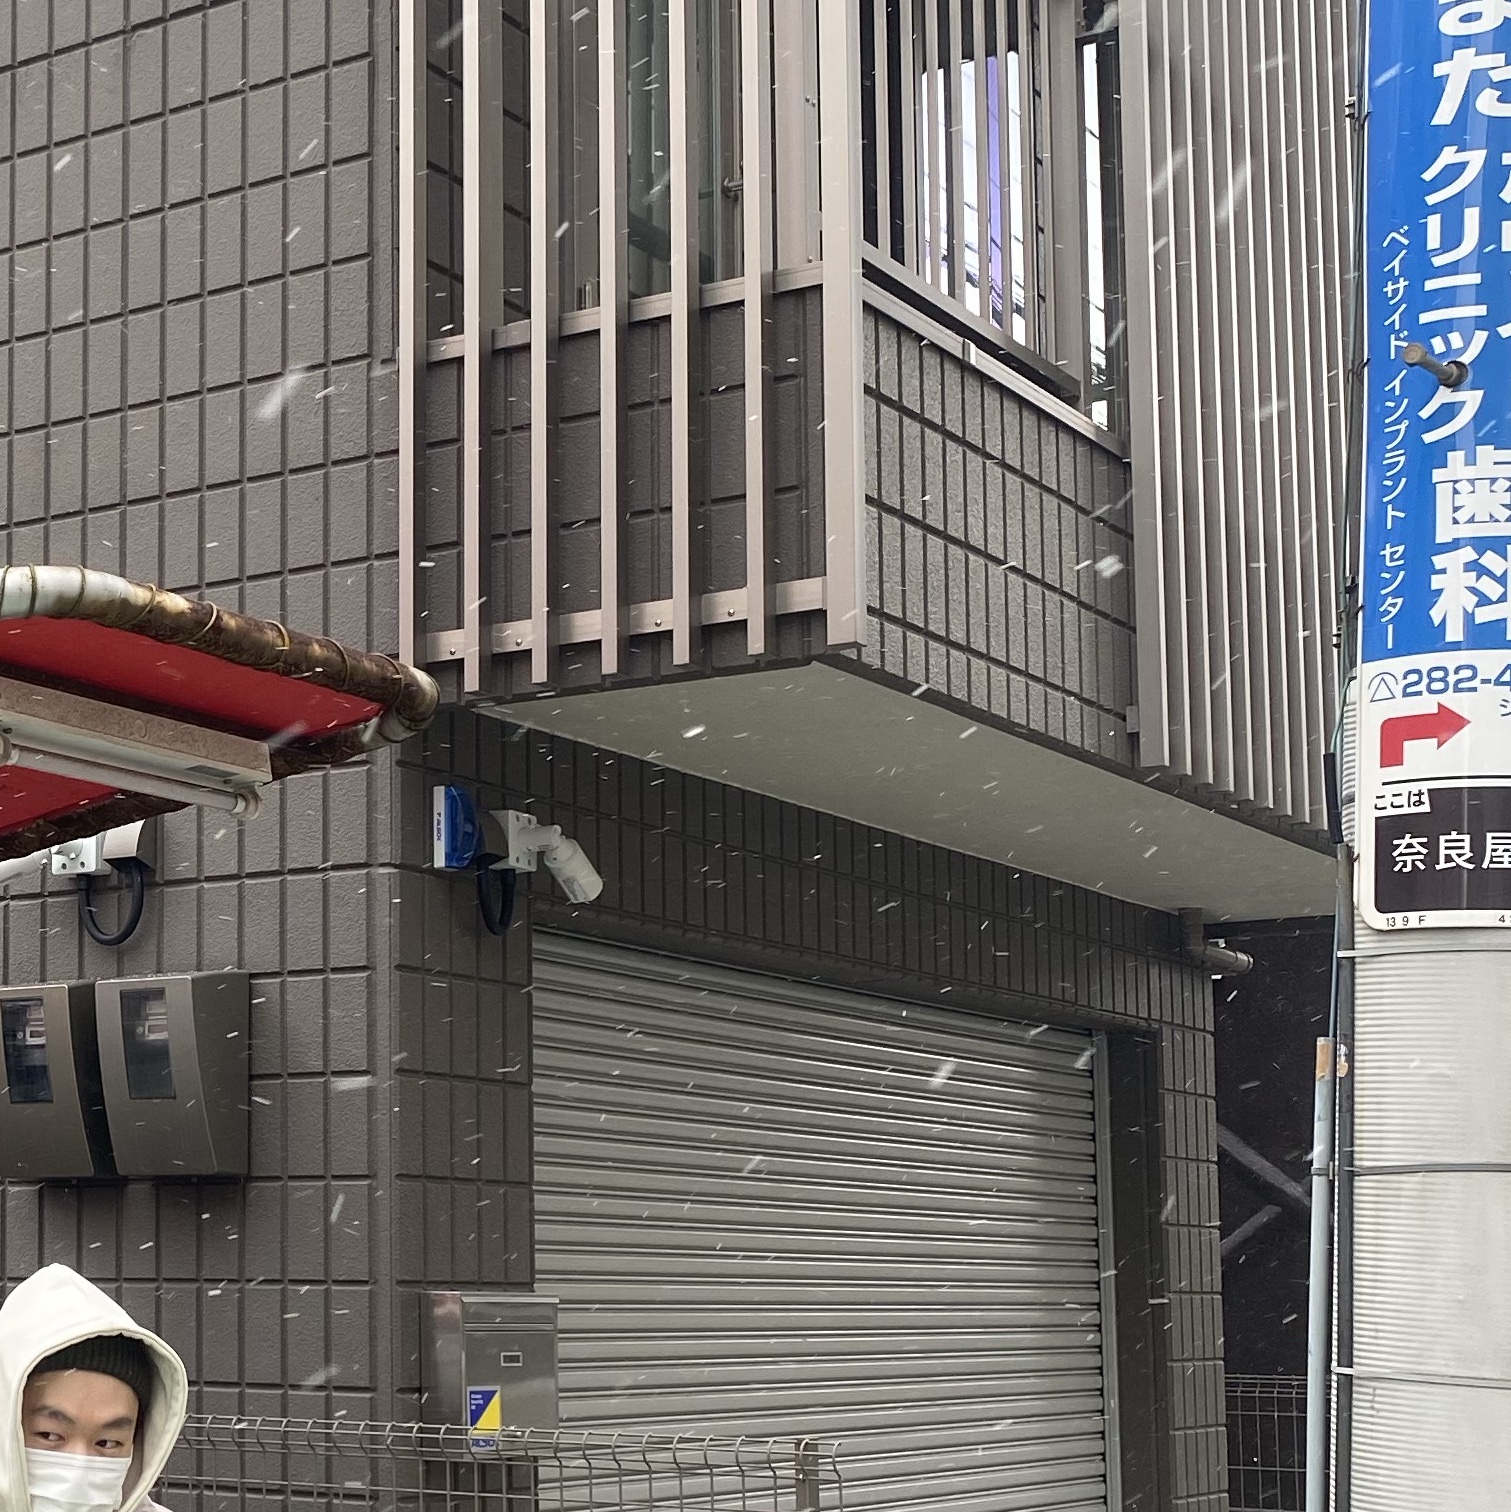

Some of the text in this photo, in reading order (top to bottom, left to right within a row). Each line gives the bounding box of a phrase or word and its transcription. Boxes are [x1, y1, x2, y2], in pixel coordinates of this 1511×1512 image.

[1379, 224, 1409, 649] ベイサイド インプラント センター
[1418, 145, 1488, 445] クリニック
[1374, 789, 1425, 812] ここは
